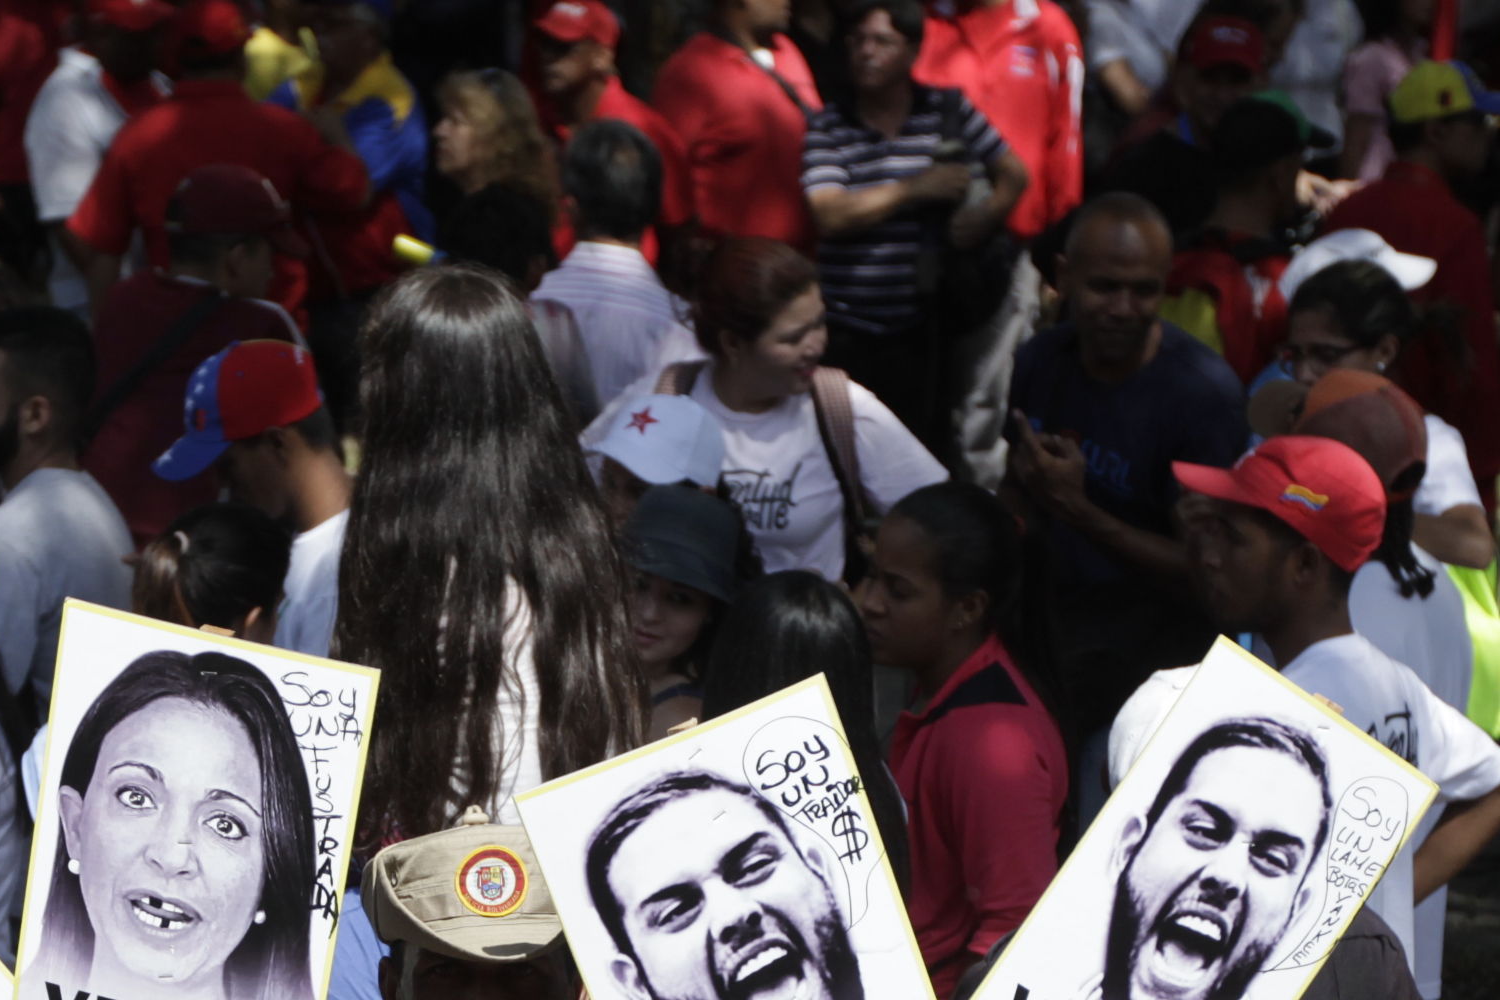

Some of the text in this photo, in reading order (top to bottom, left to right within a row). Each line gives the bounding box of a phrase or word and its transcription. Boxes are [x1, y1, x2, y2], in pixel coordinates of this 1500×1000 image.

[756, 734, 831, 790] Soy
[781, 764, 829, 807] UN
[1341, 786, 1401, 842] Soy
[1336, 826, 1375, 853] UN
[1330, 848, 1384, 877] LAME
